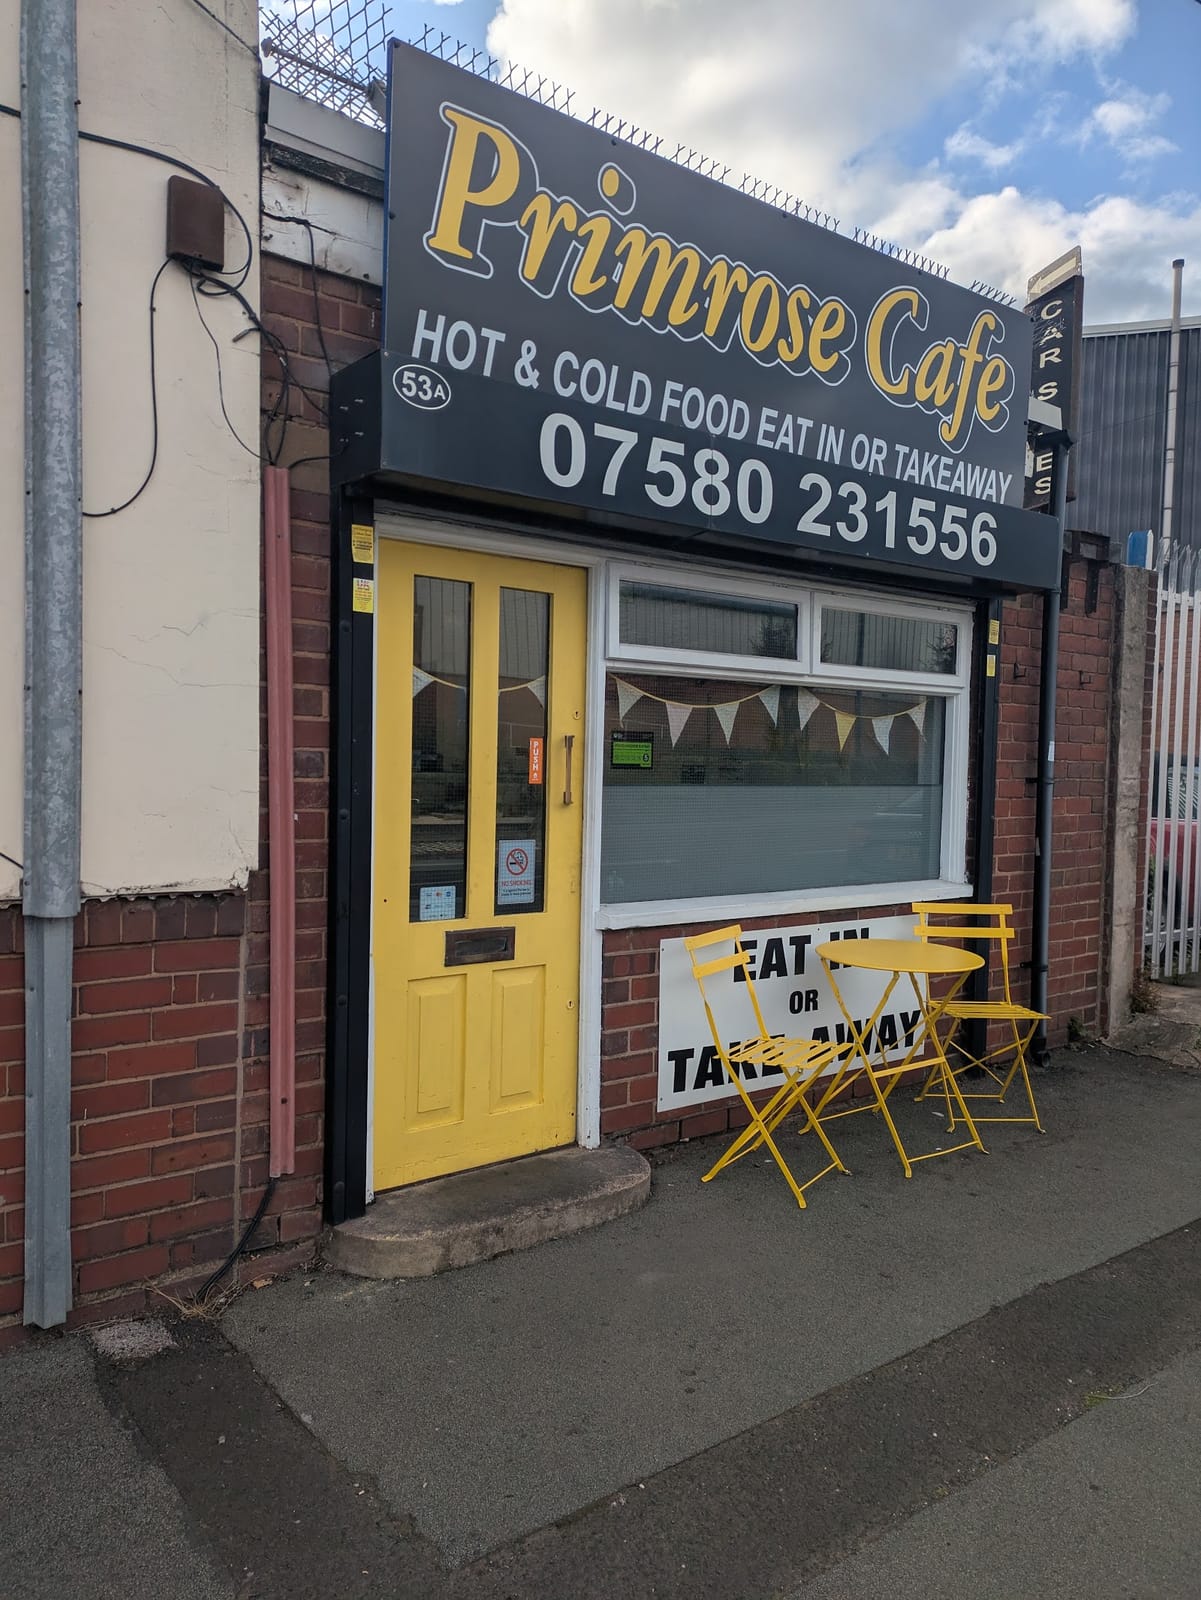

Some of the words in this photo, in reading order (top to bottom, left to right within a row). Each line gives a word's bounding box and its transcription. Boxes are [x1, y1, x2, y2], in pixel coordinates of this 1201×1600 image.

[427, 106, 848, 374] Primrose
[866, 288, 1008, 444] Cafe
[1040, 300, 1064, 369] CAR
[401, 370, 446, 401] 53A
[411, 308, 507, 378] HOT
[514, 339, 541, 390] &
[553, 350, 653, 416] COLD
[659, 379, 751, 441] FOOD
[756, 406, 814, 456] EAT
[816, 423, 846, 465] IN
[850, 433, 887, 476] OR
[895, 443, 1013, 505] TAKEAWAY
[539, 412, 774, 525] 07580
[796, 472, 998, 567] 231556
[733, 934, 812, 983] EAT
[789, 988, 819, 1015] OR
